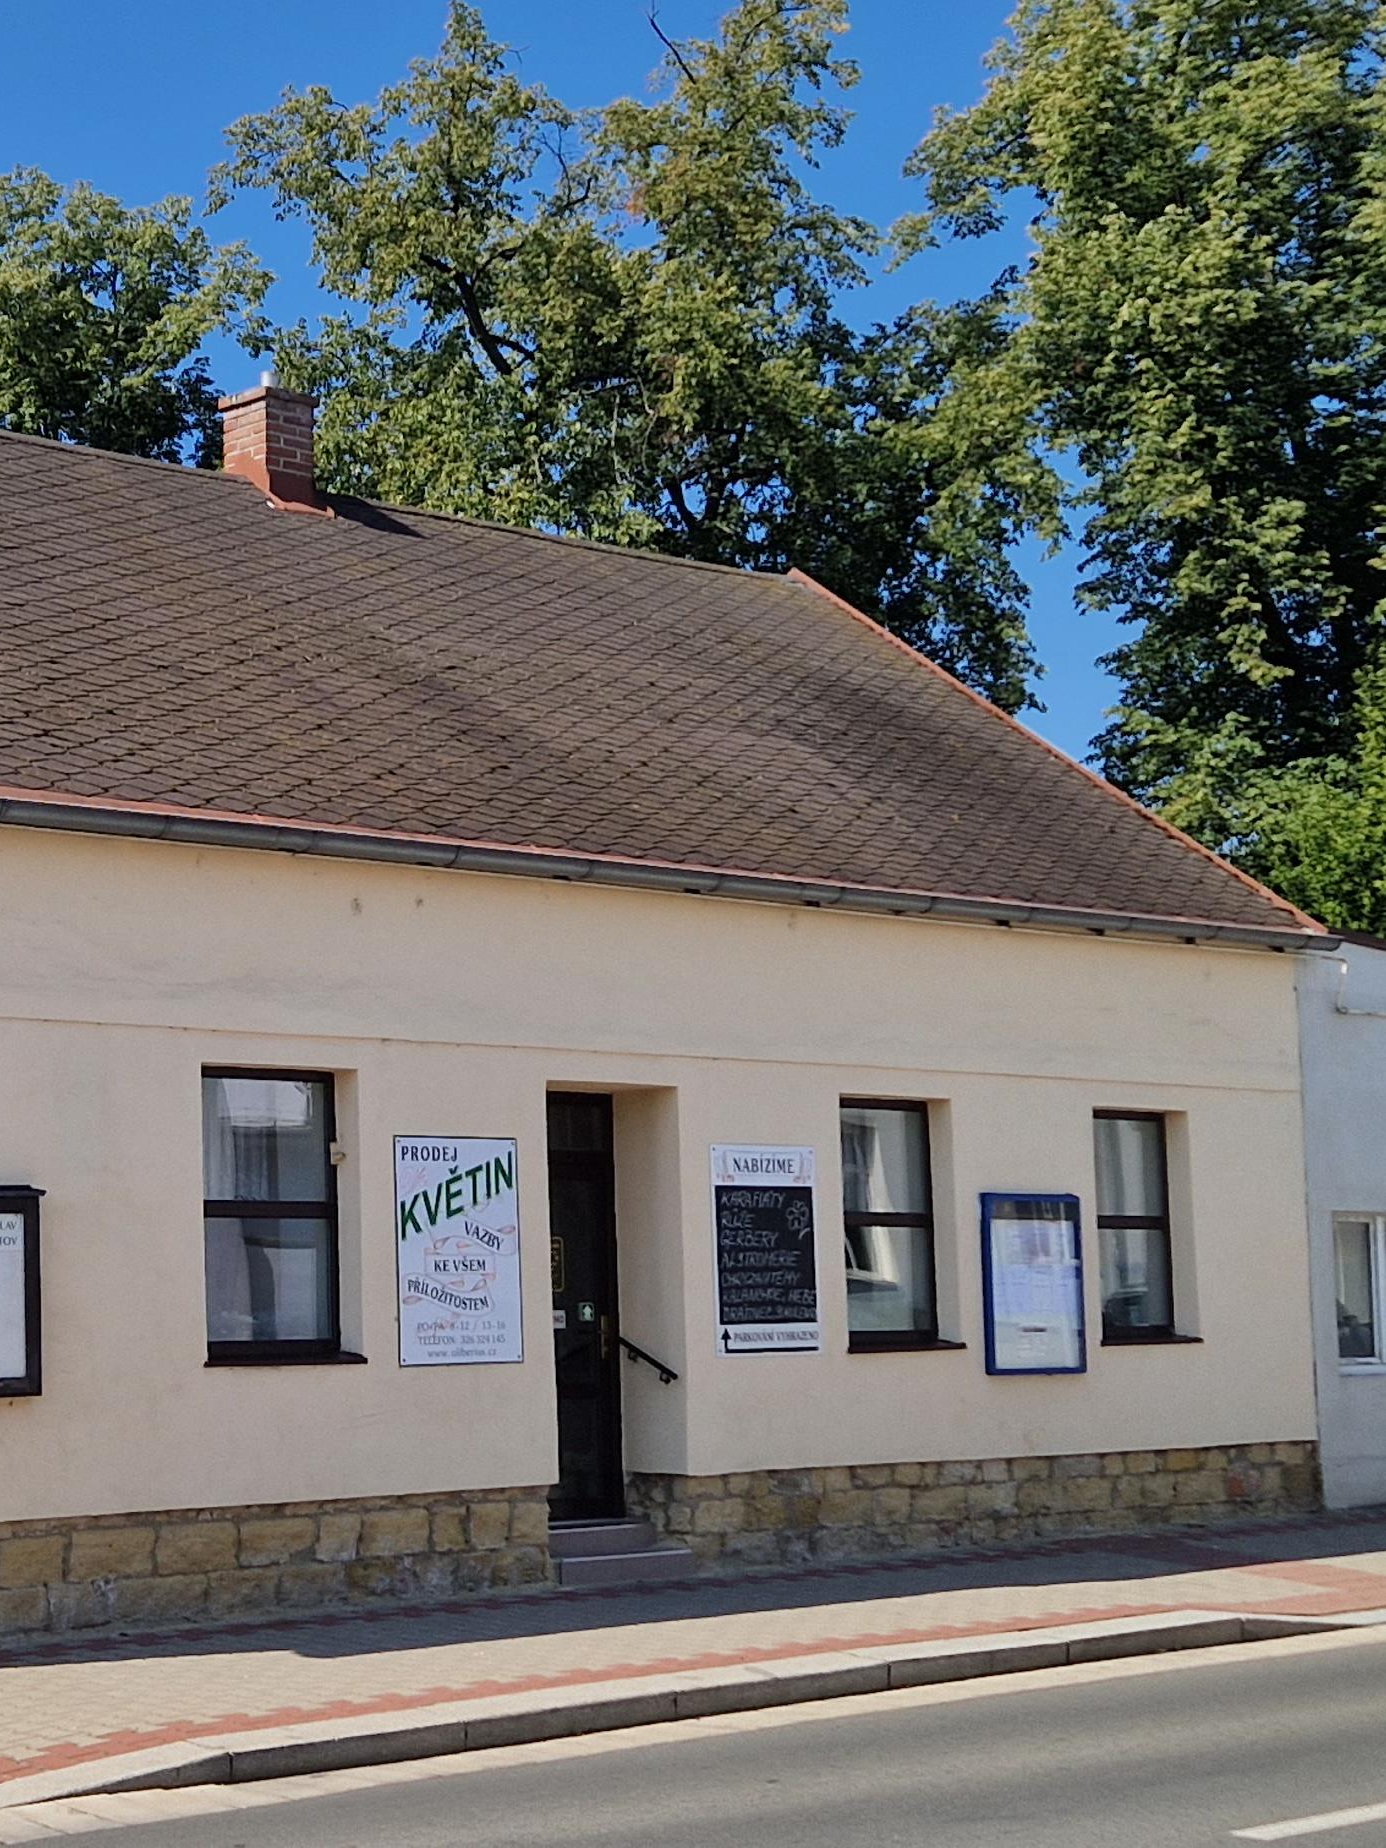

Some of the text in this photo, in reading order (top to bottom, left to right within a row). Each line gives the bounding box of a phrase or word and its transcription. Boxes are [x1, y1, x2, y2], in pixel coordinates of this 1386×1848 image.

[401, 1145, 458, 1162] PRODEJ
[733, 1153, 796, 1174] NABÍZÍME
[400, 1151, 514, 1241] KVĚTIN
[464, 1220, 505, 1251] VAZBY
[434, 1255, 486, 1273] KE VŠEM
